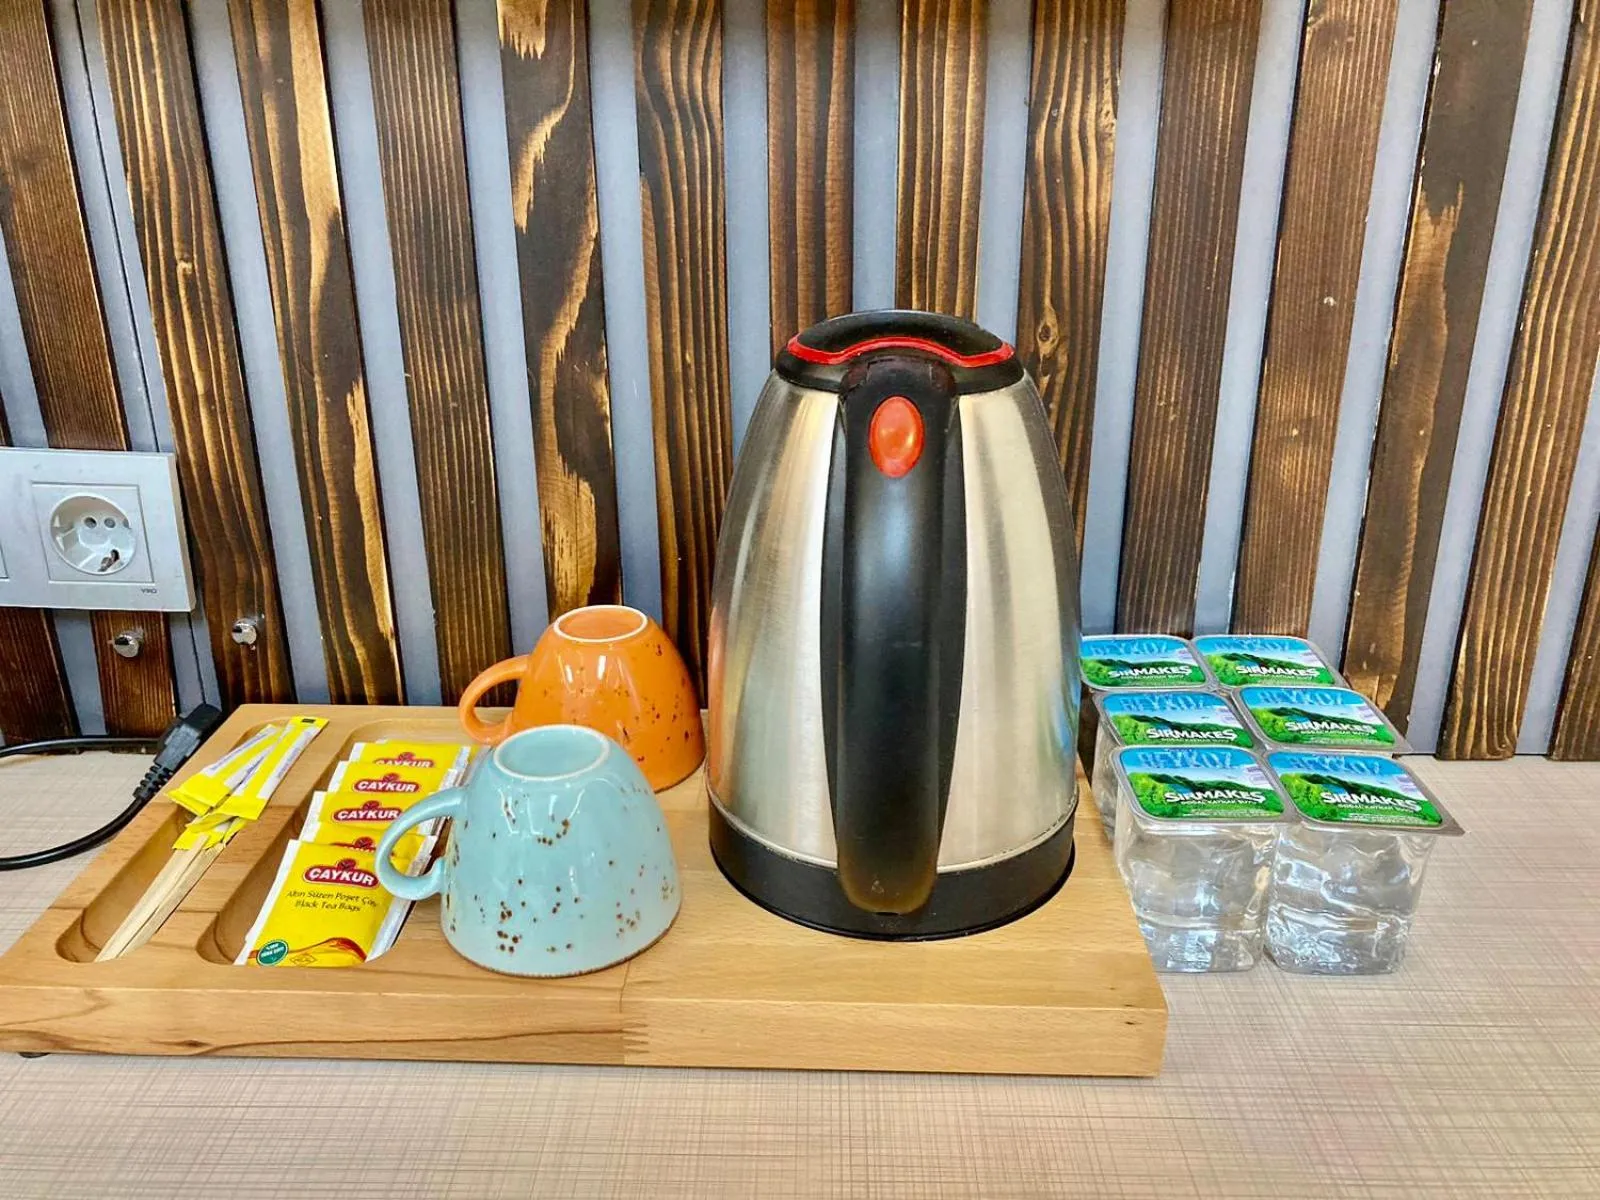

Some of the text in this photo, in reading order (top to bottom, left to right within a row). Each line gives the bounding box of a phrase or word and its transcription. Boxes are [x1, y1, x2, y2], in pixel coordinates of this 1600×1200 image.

[1146, 728, 1238, 741] SIRMAKES
[1164, 789, 1267, 803] SIRMAKES
[1319, 792, 1422, 812] SIRMAKES
